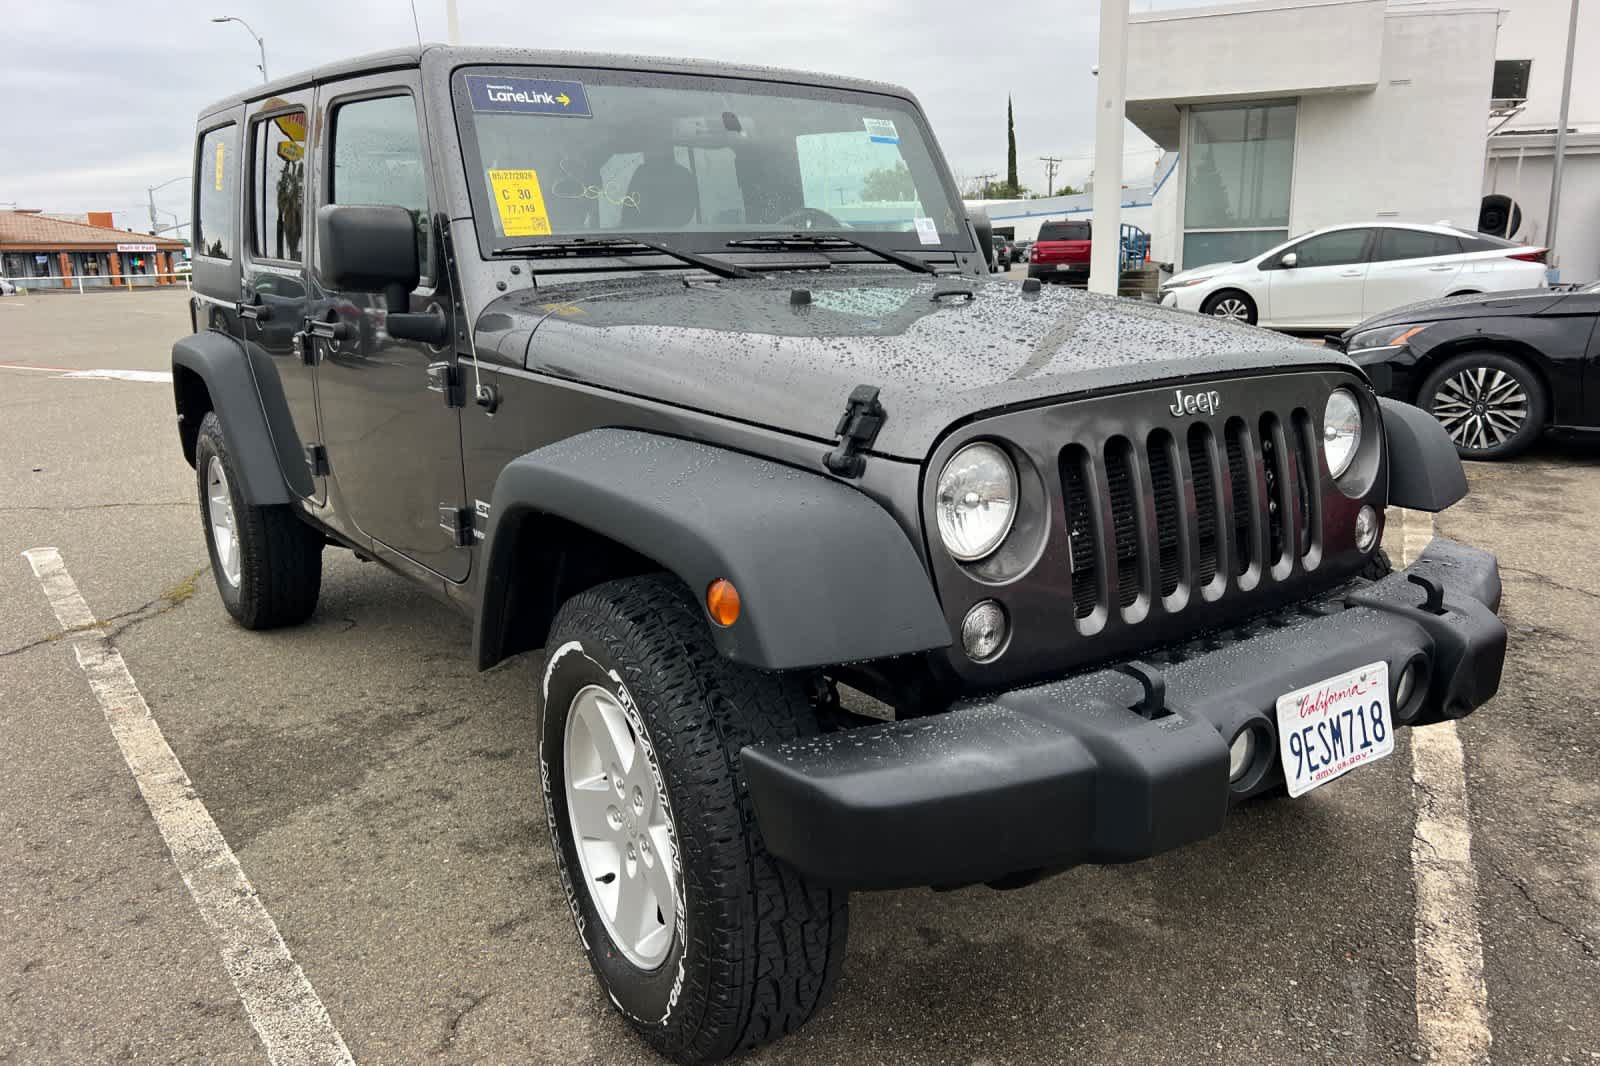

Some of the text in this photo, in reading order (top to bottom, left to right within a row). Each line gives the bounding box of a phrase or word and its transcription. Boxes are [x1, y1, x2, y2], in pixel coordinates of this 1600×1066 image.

[488, 89, 556, 104] LaneLink
[502, 189, 531, 200] C 30
[1169, 390, 1220, 417] Jeep
[1298, 684, 1367, 719] California
[1289, 700, 1386, 781] 9ESM718
[1315, 752, 1368, 781] dmv.ca.gov
